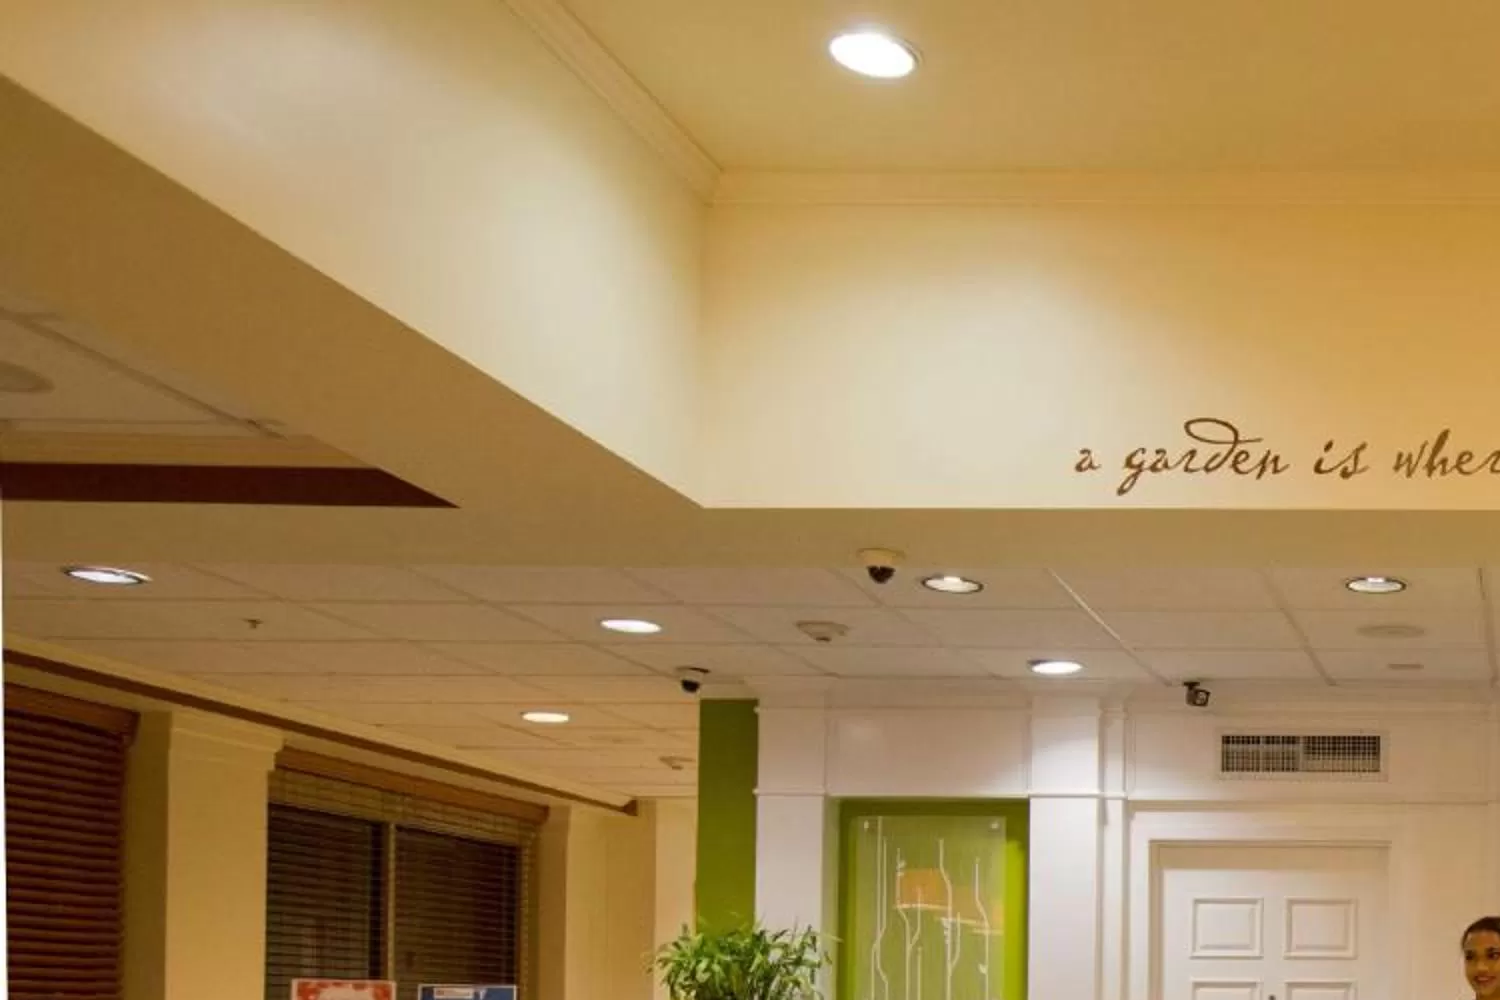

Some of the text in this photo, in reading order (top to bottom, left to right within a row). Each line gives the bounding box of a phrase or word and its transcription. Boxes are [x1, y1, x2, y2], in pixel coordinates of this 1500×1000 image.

[1074, 447, 1101, 472] a
[1116, 417, 1290, 497] garden
[1313, 439, 1370, 480] is
